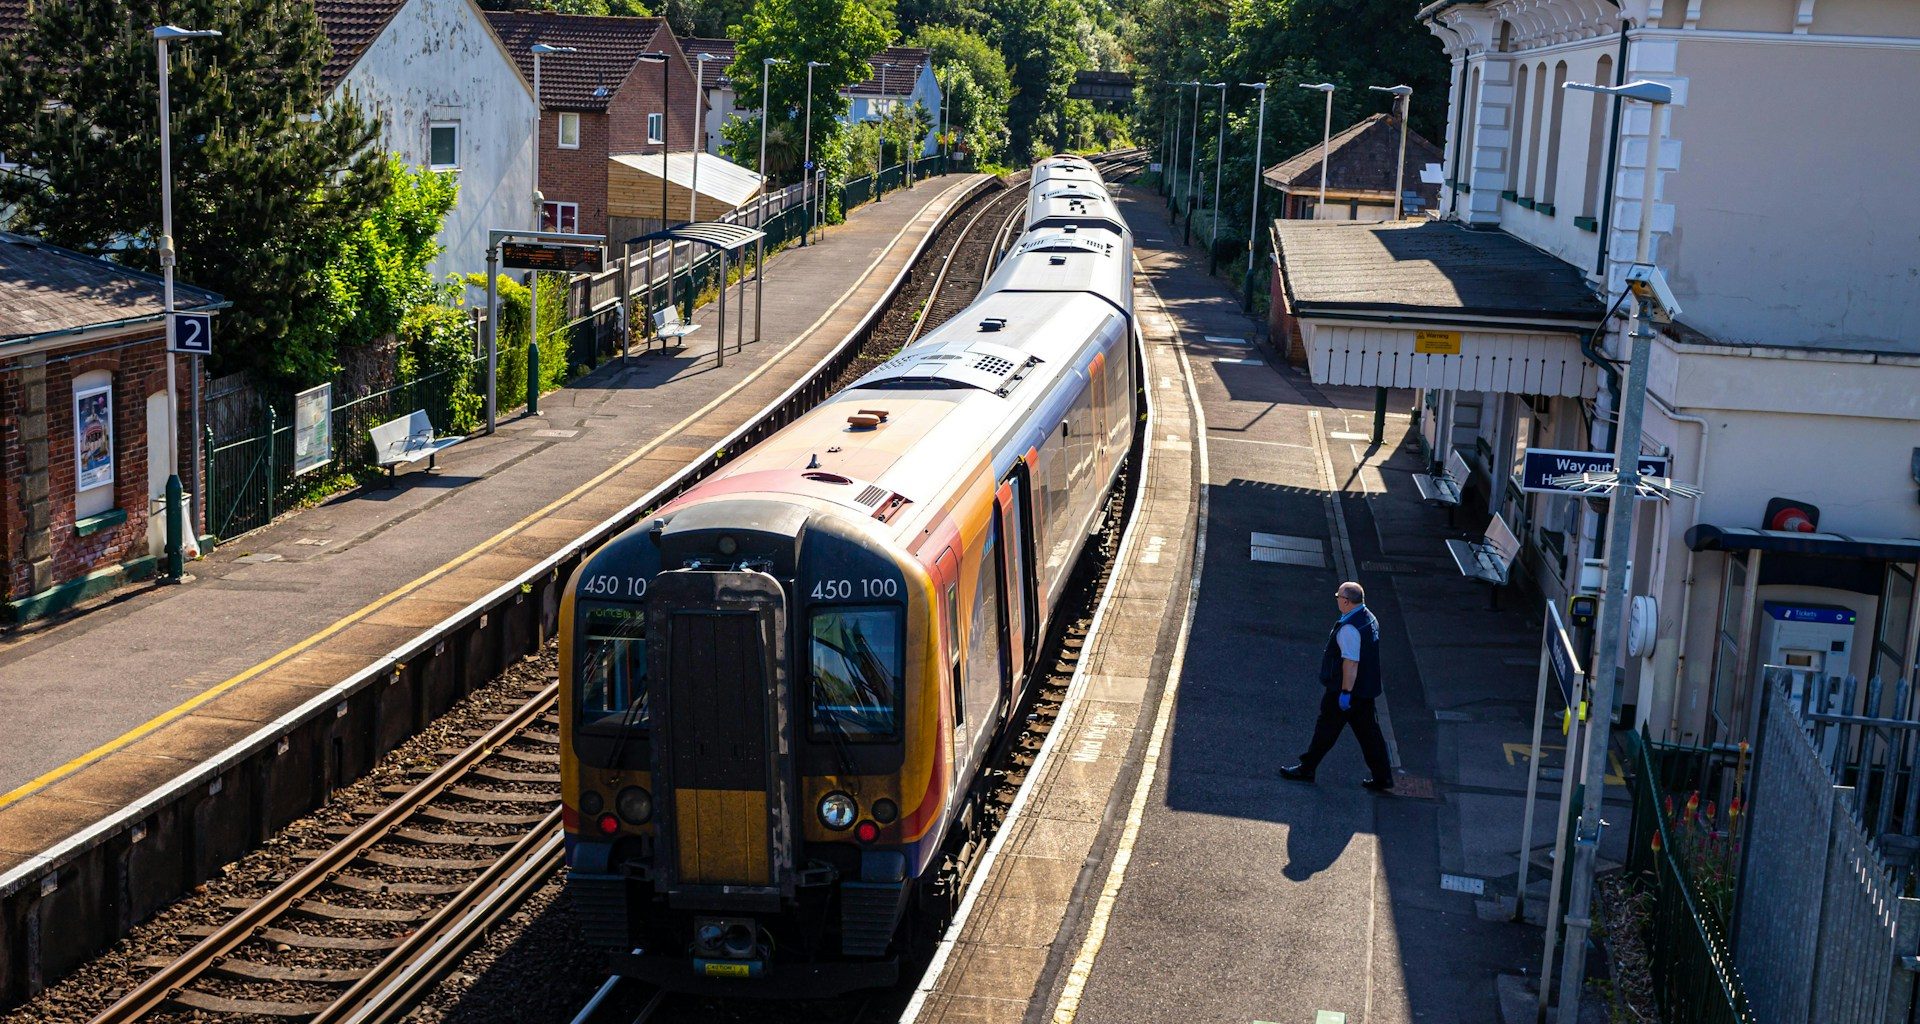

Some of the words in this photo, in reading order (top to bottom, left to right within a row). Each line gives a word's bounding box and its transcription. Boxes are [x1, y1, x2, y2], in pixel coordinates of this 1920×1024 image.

[184, 319, 202, 347] 2
[1426, 331, 1449, 340] Warning
[1556, 458, 1586, 474] Way
[1588, 462, 1612, 473] out
[584, 574, 619, 594] 450
[627, 576, 650, 597] 10
[811, 579, 852, 599] 450
[861, 578, 897, 598] 100
[1795, 609, 1817, 617] Tickets
